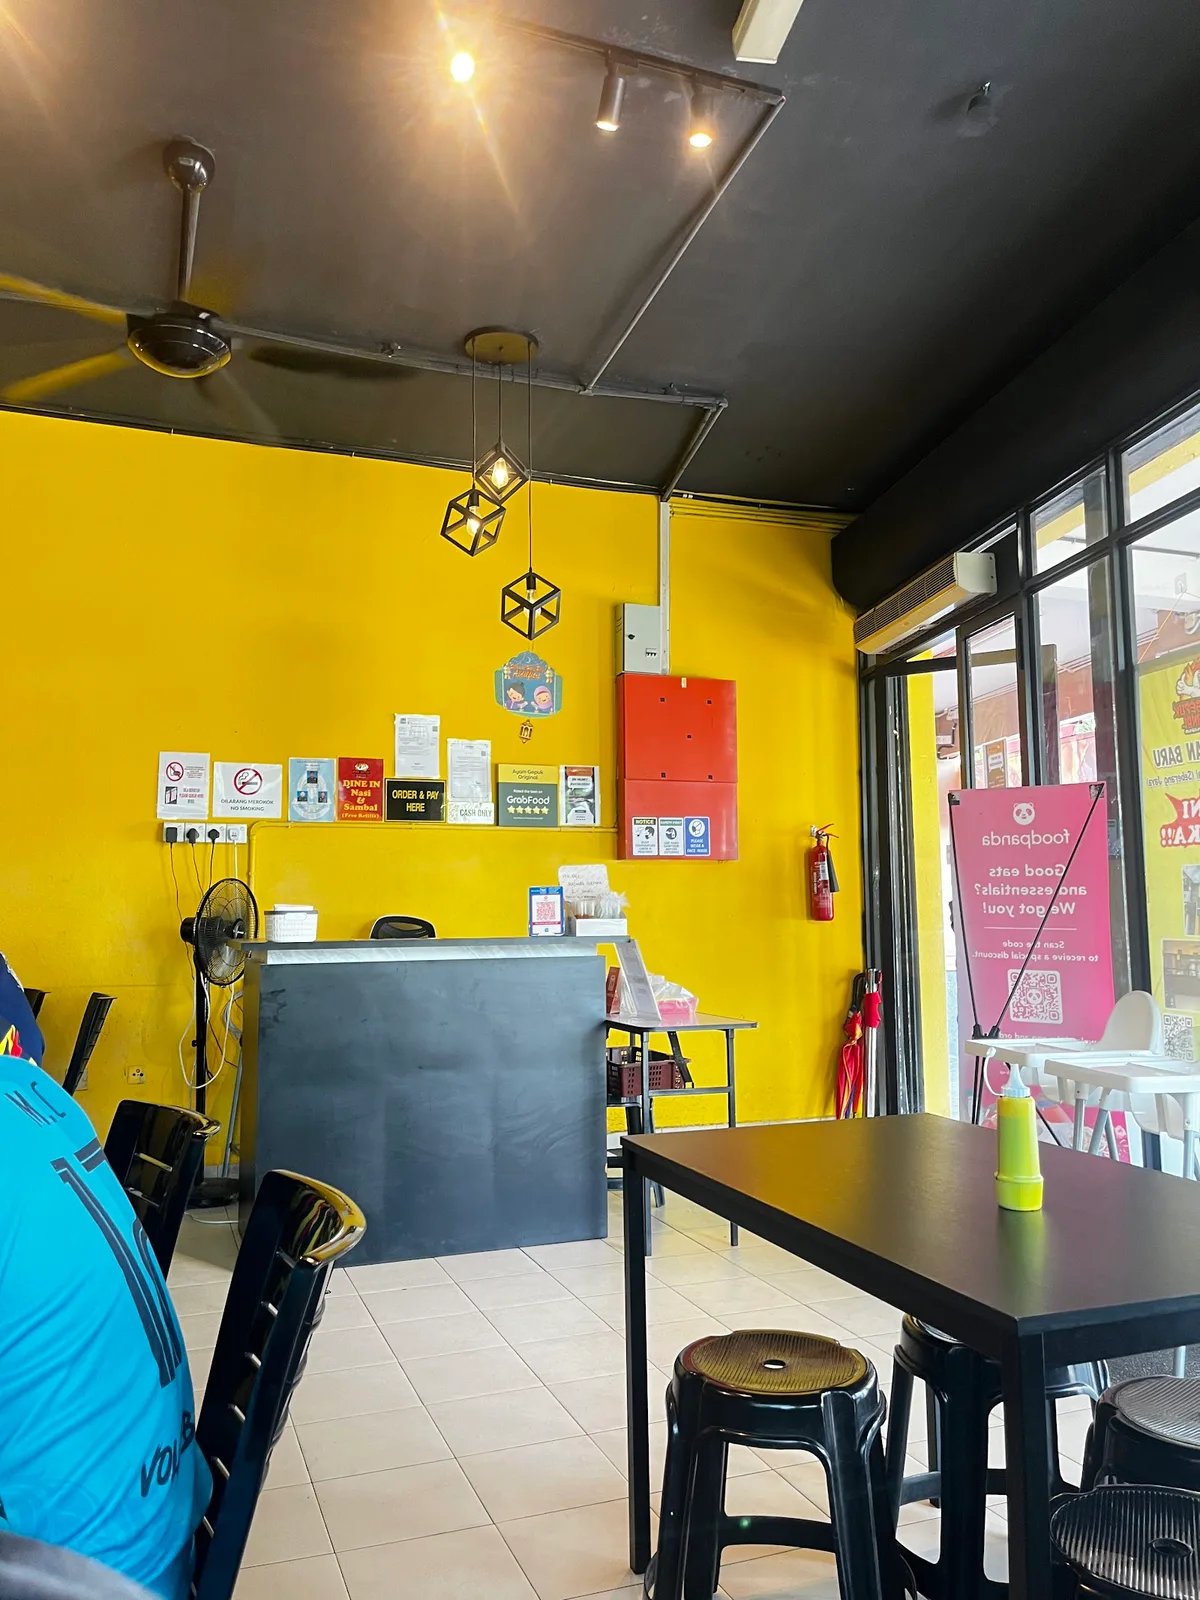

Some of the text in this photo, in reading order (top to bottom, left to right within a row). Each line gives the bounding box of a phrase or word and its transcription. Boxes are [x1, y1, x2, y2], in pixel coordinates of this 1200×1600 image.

[343, 780, 380, 788] DINE IN
[351, 789, 371, 797] Nasi
[392, 790, 440, 800] ORDER & PAY
[506, 795, 550, 804] GrabFood
[343, 803, 378, 811] Sambal
[406, 803, 425, 812] HERE
[459, 808, 492, 818] CASH ONLY
